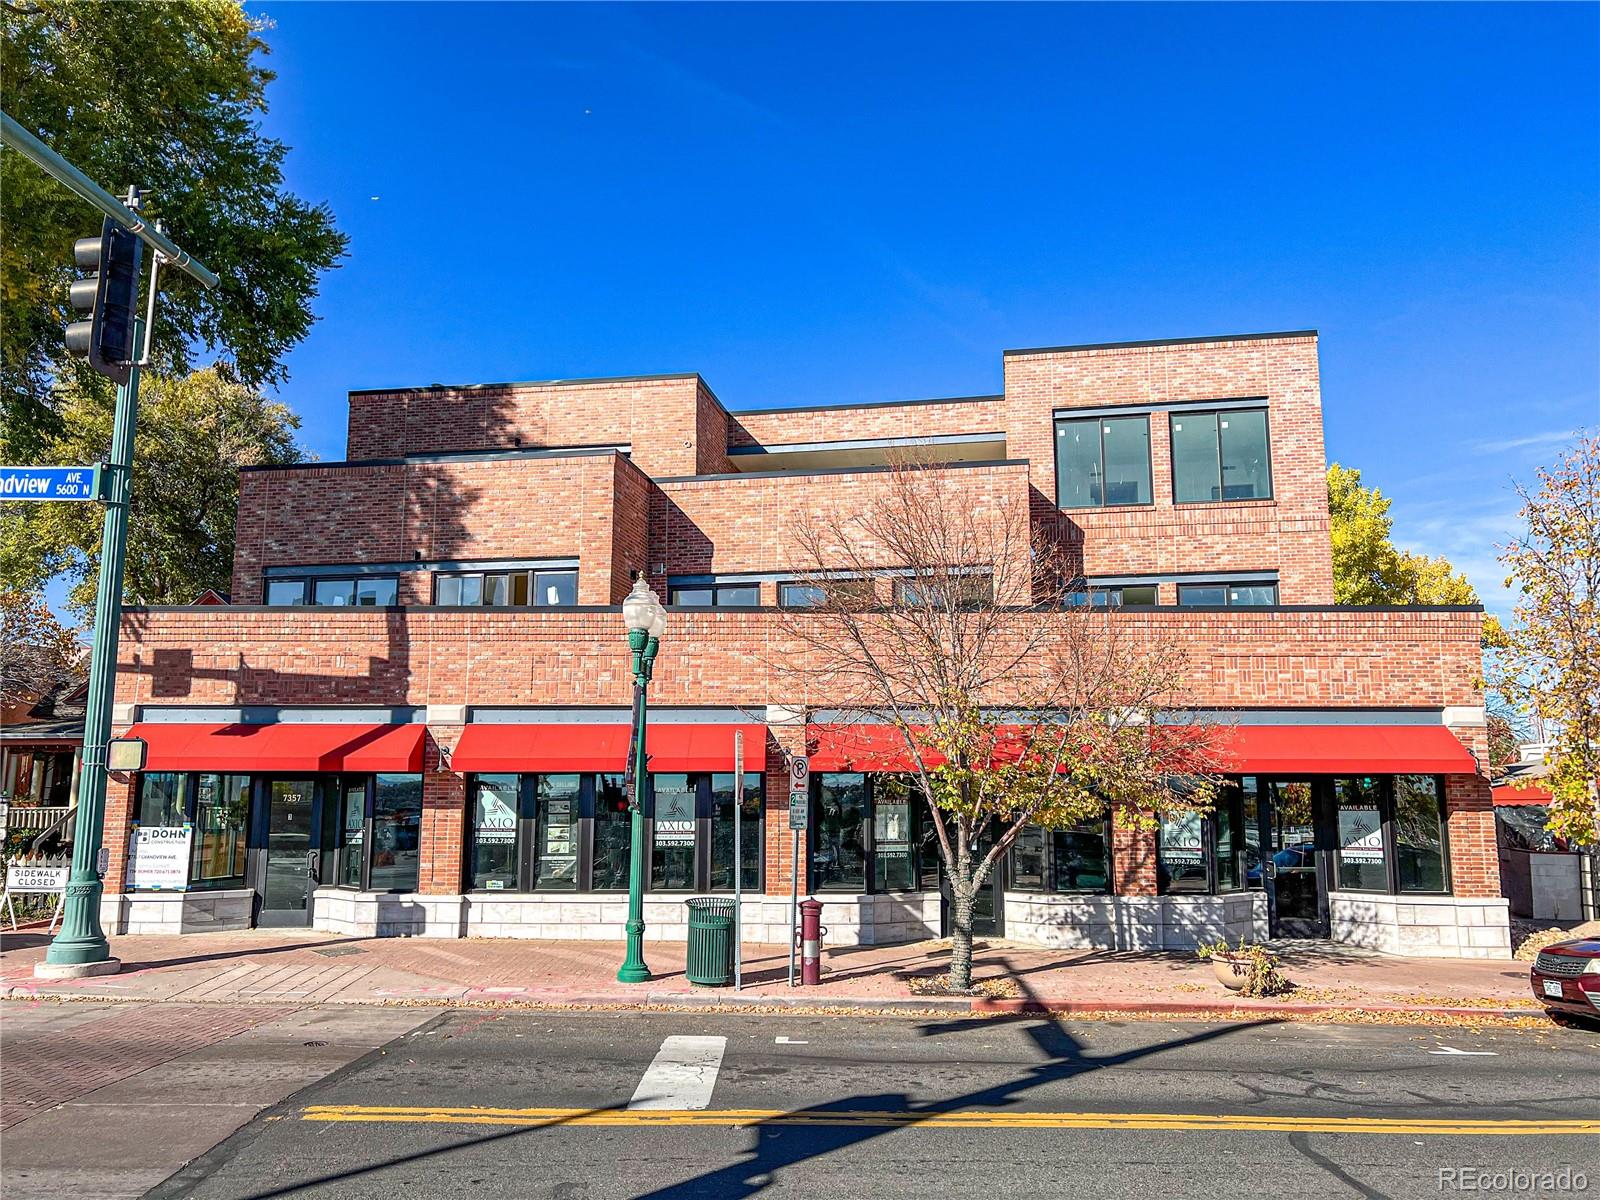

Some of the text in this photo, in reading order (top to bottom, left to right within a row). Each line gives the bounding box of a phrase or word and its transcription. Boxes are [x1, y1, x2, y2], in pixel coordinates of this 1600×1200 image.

[65, 472, 84, 484] AVE.
[56, 484, 90, 495] 5600 N
[282, 794, 302, 803] 7357
[479, 817, 514, 828] AXIO
[658, 820, 693, 831] AXIO
[152, 830, 187, 838] DOHN
[1163, 837, 1200, 847] AXIO
[1343, 836, 1381, 847] AXIO
[1343, 857, 1382, 865] 303.592.7300
